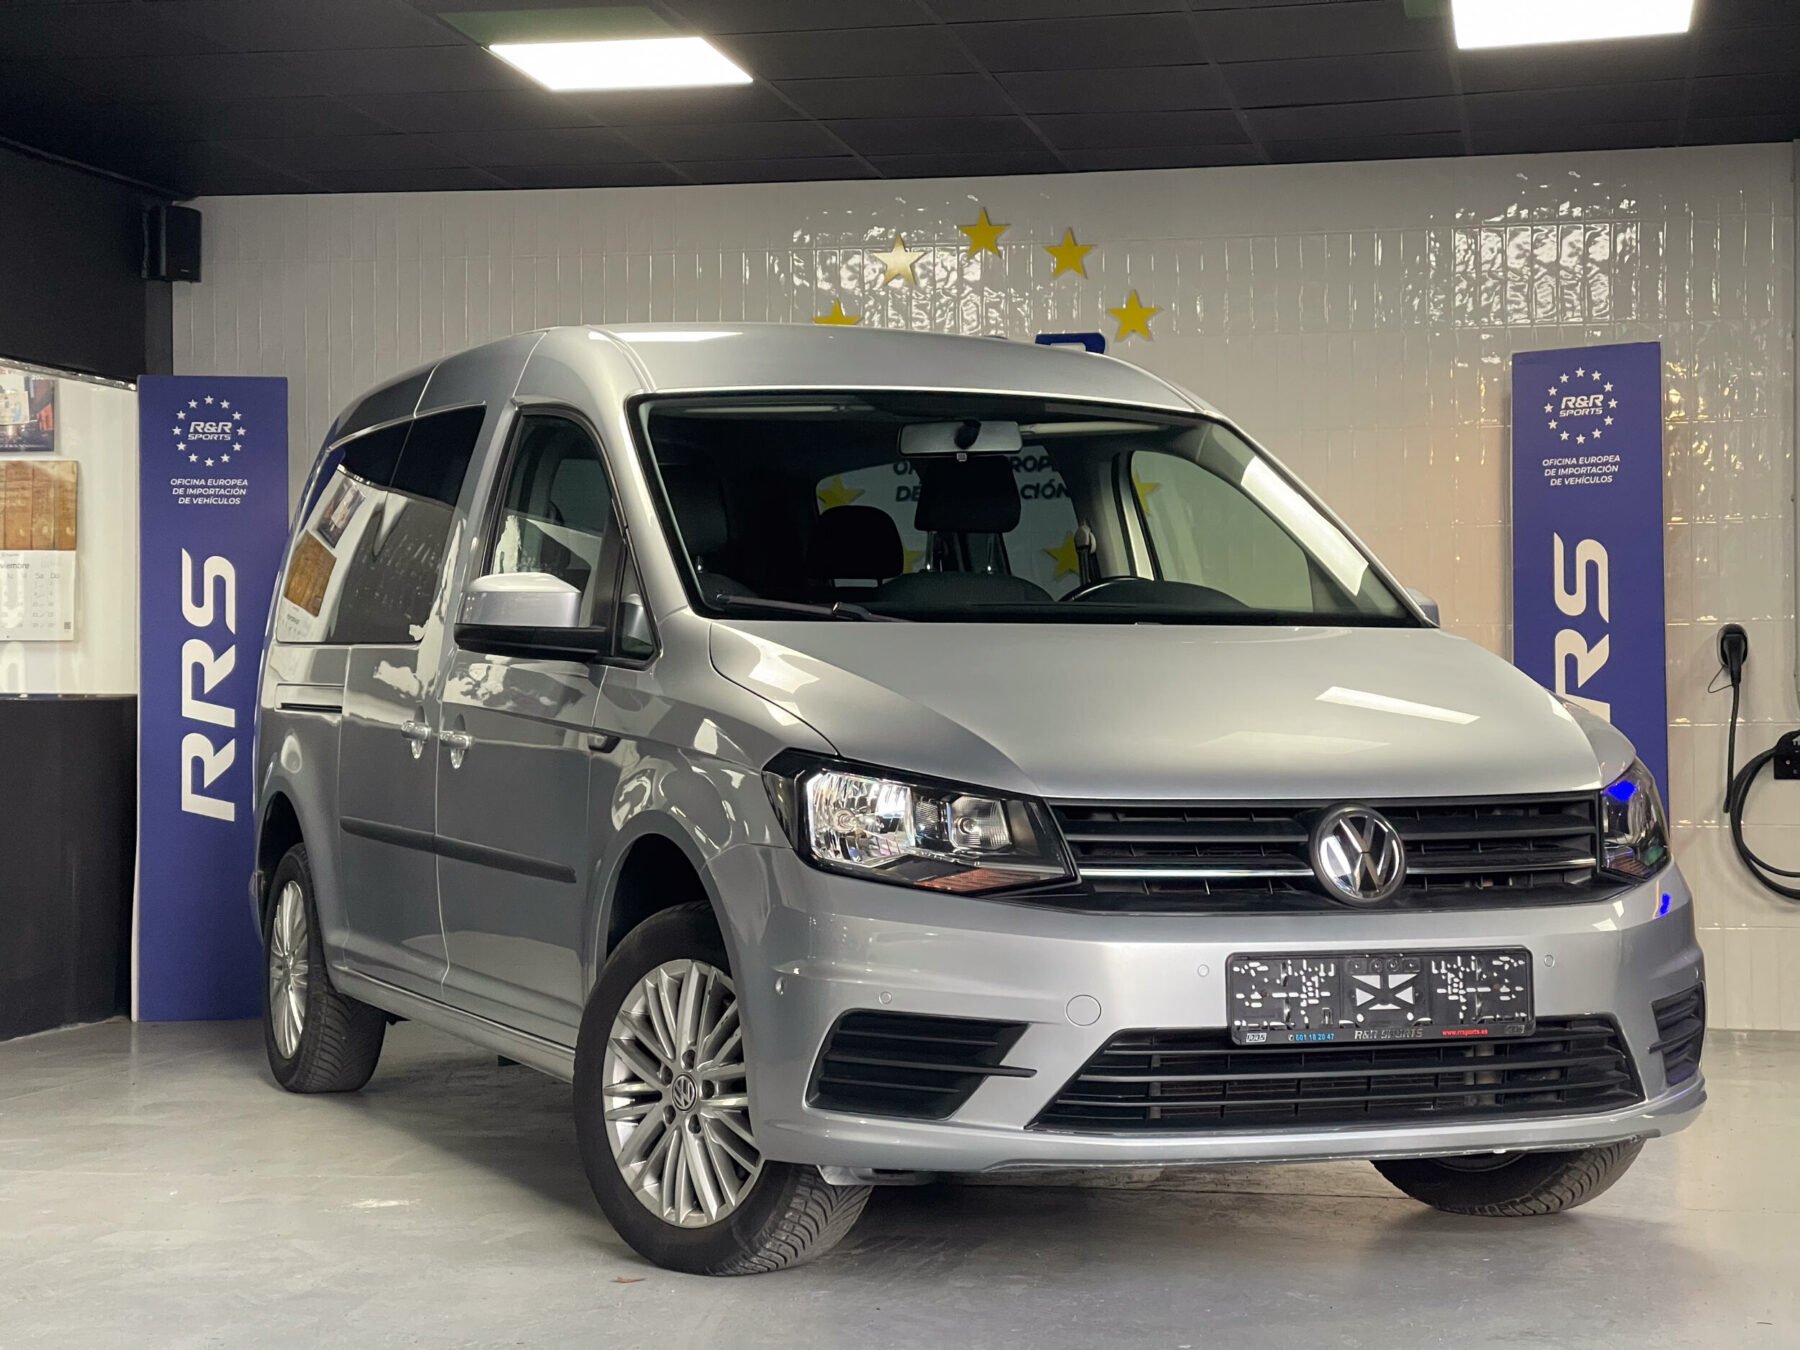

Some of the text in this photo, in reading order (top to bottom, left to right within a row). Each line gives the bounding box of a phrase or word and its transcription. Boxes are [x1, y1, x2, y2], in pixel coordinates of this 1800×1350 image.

[1561, 394, 1604, 409] R&R
[1559, 407, 1603, 417] SPORTS
[189, 421, 232, 433] R&R
[187, 433, 232, 441] SPORTS
[1542, 454, 1621, 467] OFICINA EUROPEA
[1544, 464, 1619, 477] DE IMPORTACIÓN
[170, 478, 248, 486] OFICINA EUROPEA
[1550, 475, 1613, 486] DE VEHÍCULOS
[186, 487, 247, 495] IMPORTACIÓN
[192, 496, 241, 505] VEHÍCULOS
[1554, 532, 1611, 724] RS
[182, 548, 235, 822] RRS
